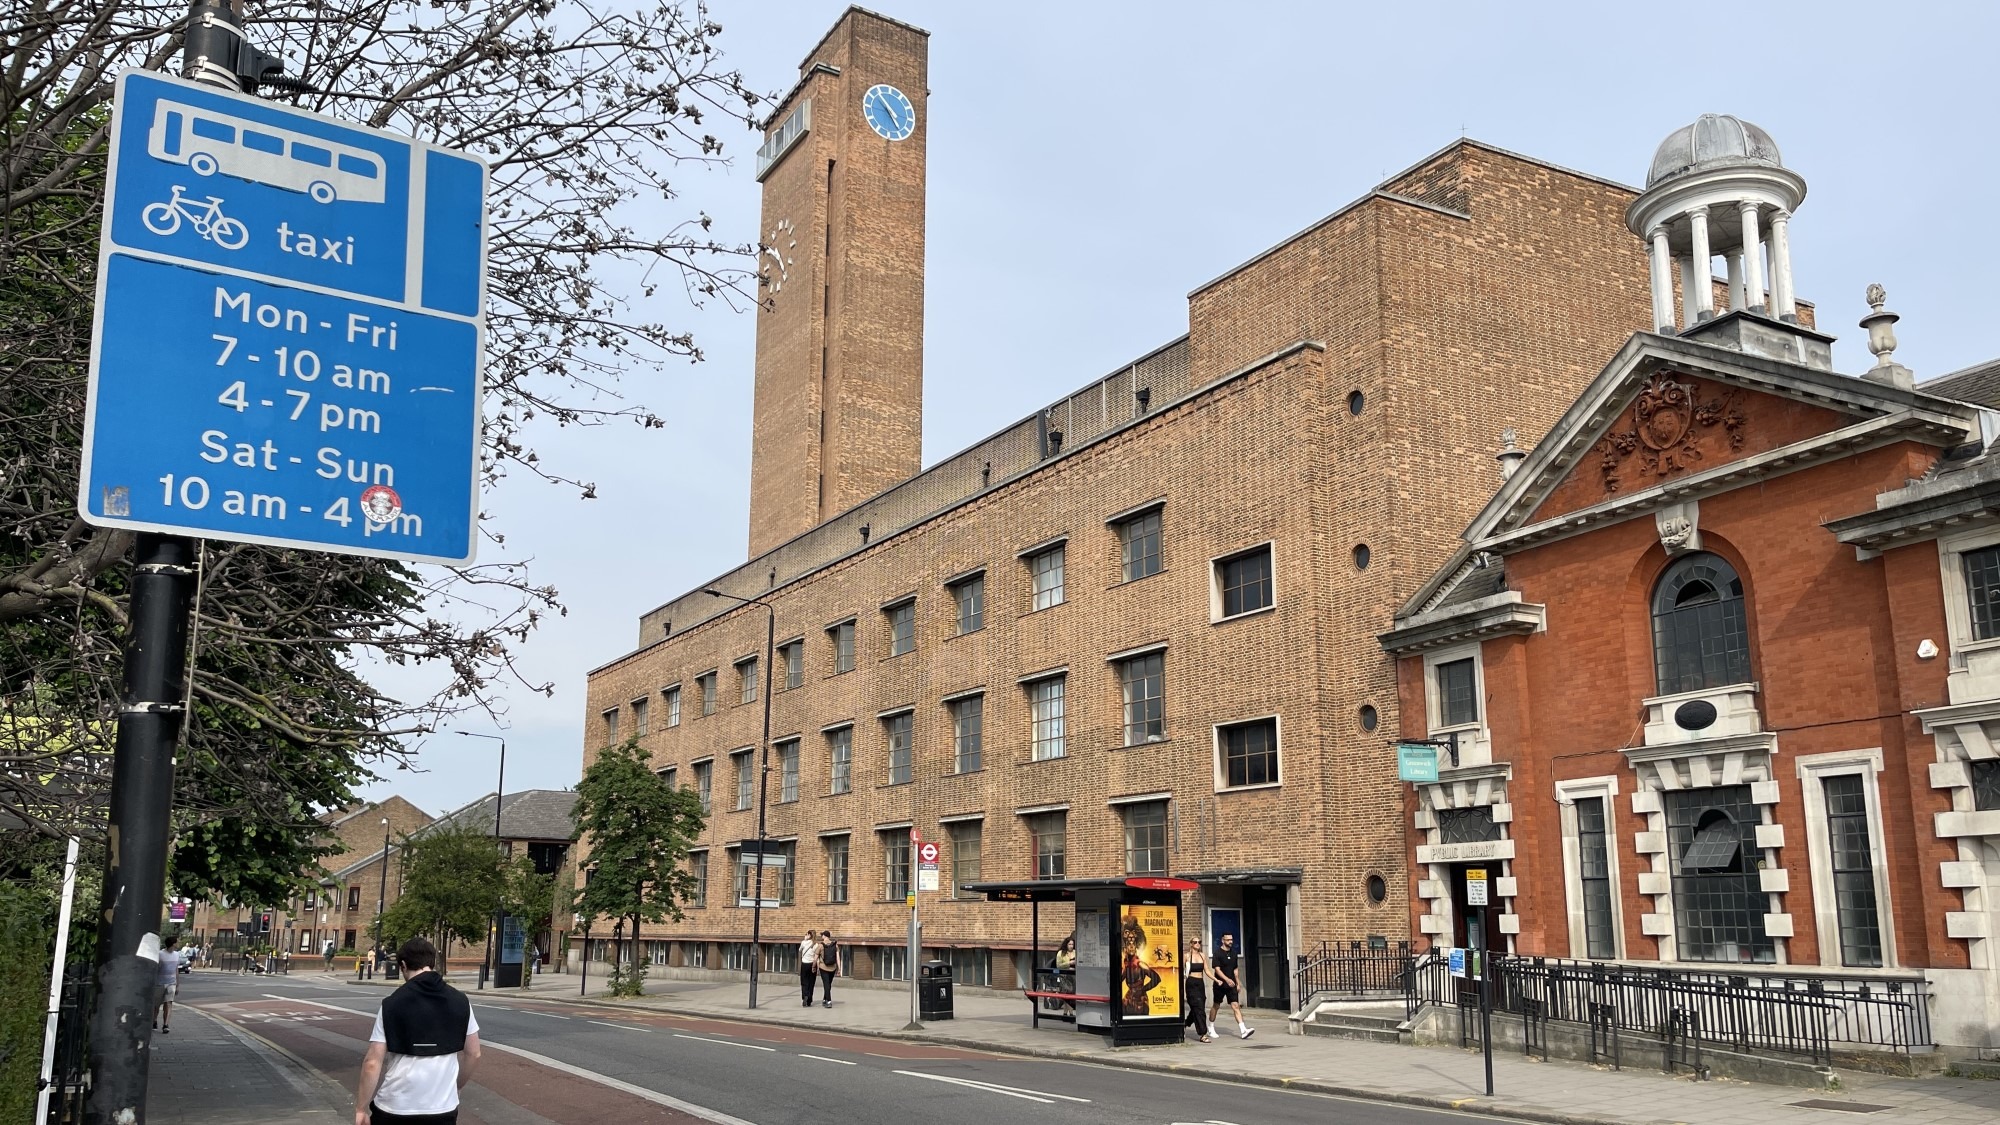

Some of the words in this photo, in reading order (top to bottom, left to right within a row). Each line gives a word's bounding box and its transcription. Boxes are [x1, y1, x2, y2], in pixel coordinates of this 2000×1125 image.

[277, 223, 354, 265] taxi
[214, 287, 308, 334] Mon
[347, 314, 398, 351] Fri
[332, 364, 391, 395] am
[321, 403, 381, 434] pm
[200, 430, 278, 471] Sat
[316, 447, 394, 487] Sun
[160, 474, 210, 510] 10
[222, 490, 287, 520] am
[324, 497, 353, 528] 4
[913, 830, 919, 841] L
[1461, 842, 1496, 859] LIBRARY
[1144, 918, 1173, 927] IMAGINATION
[1145, 910, 1153, 918] LET
[1153, 910, 1163, 918] YOUR
[1151, 927, 1160, 935] RUN
